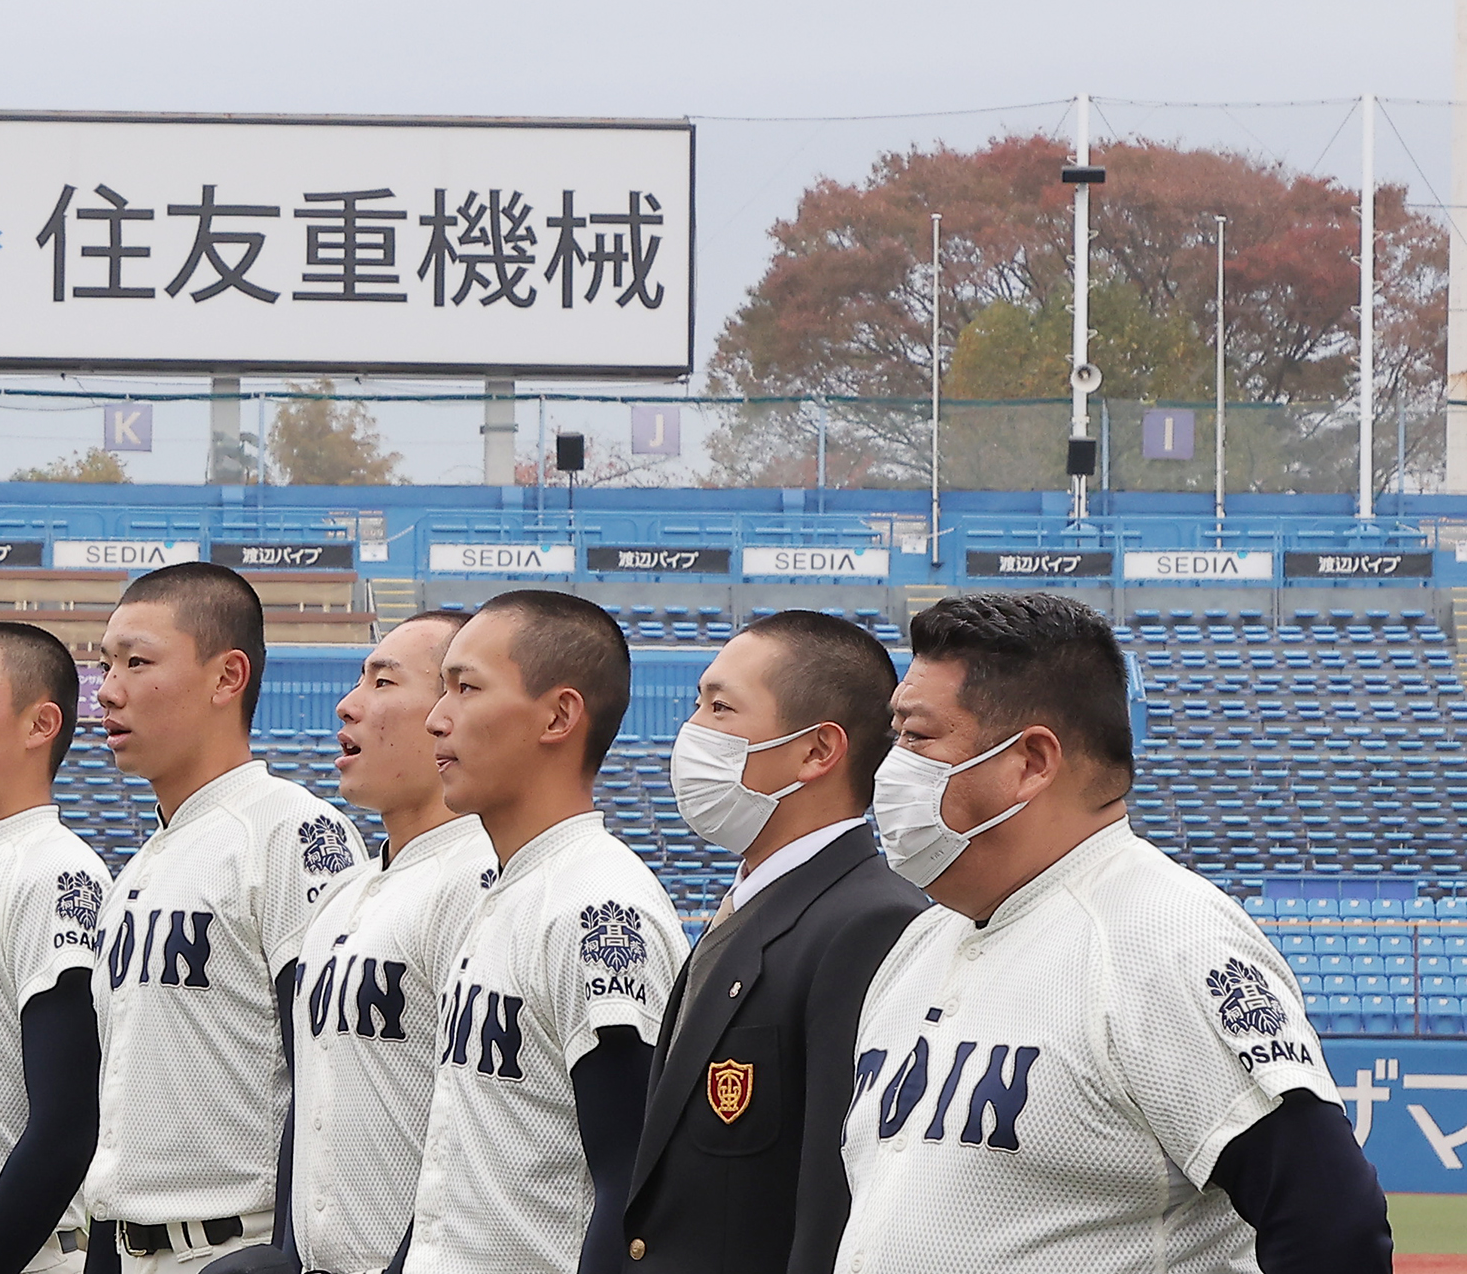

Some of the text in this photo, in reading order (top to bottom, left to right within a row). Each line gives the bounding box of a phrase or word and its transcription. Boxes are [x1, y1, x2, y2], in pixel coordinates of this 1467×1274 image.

[35, 184, 666, 310] 住友重機械
[115, 410, 142, 445] K
[649, 414, 664, 447] J
[86, 542, 167, 565] SEDIA
[241, 545, 324, 566] 渡辺パイプ
[461, 547, 543, 568] SEDIA
[618, 549, 700, 570] 渡辺パイプ
[774, 550, 857, 572] SEDIA
[999, 553, 1082, 575] 渡辺パイプ
[1317, 553, 1402, 575] 渡辺パイプ
[1156, 554, 1240, 576] SEDIA
[585, 976, 646, 1005] OSAKA
[1238, 1039, 1314, 1073] OSAKA
